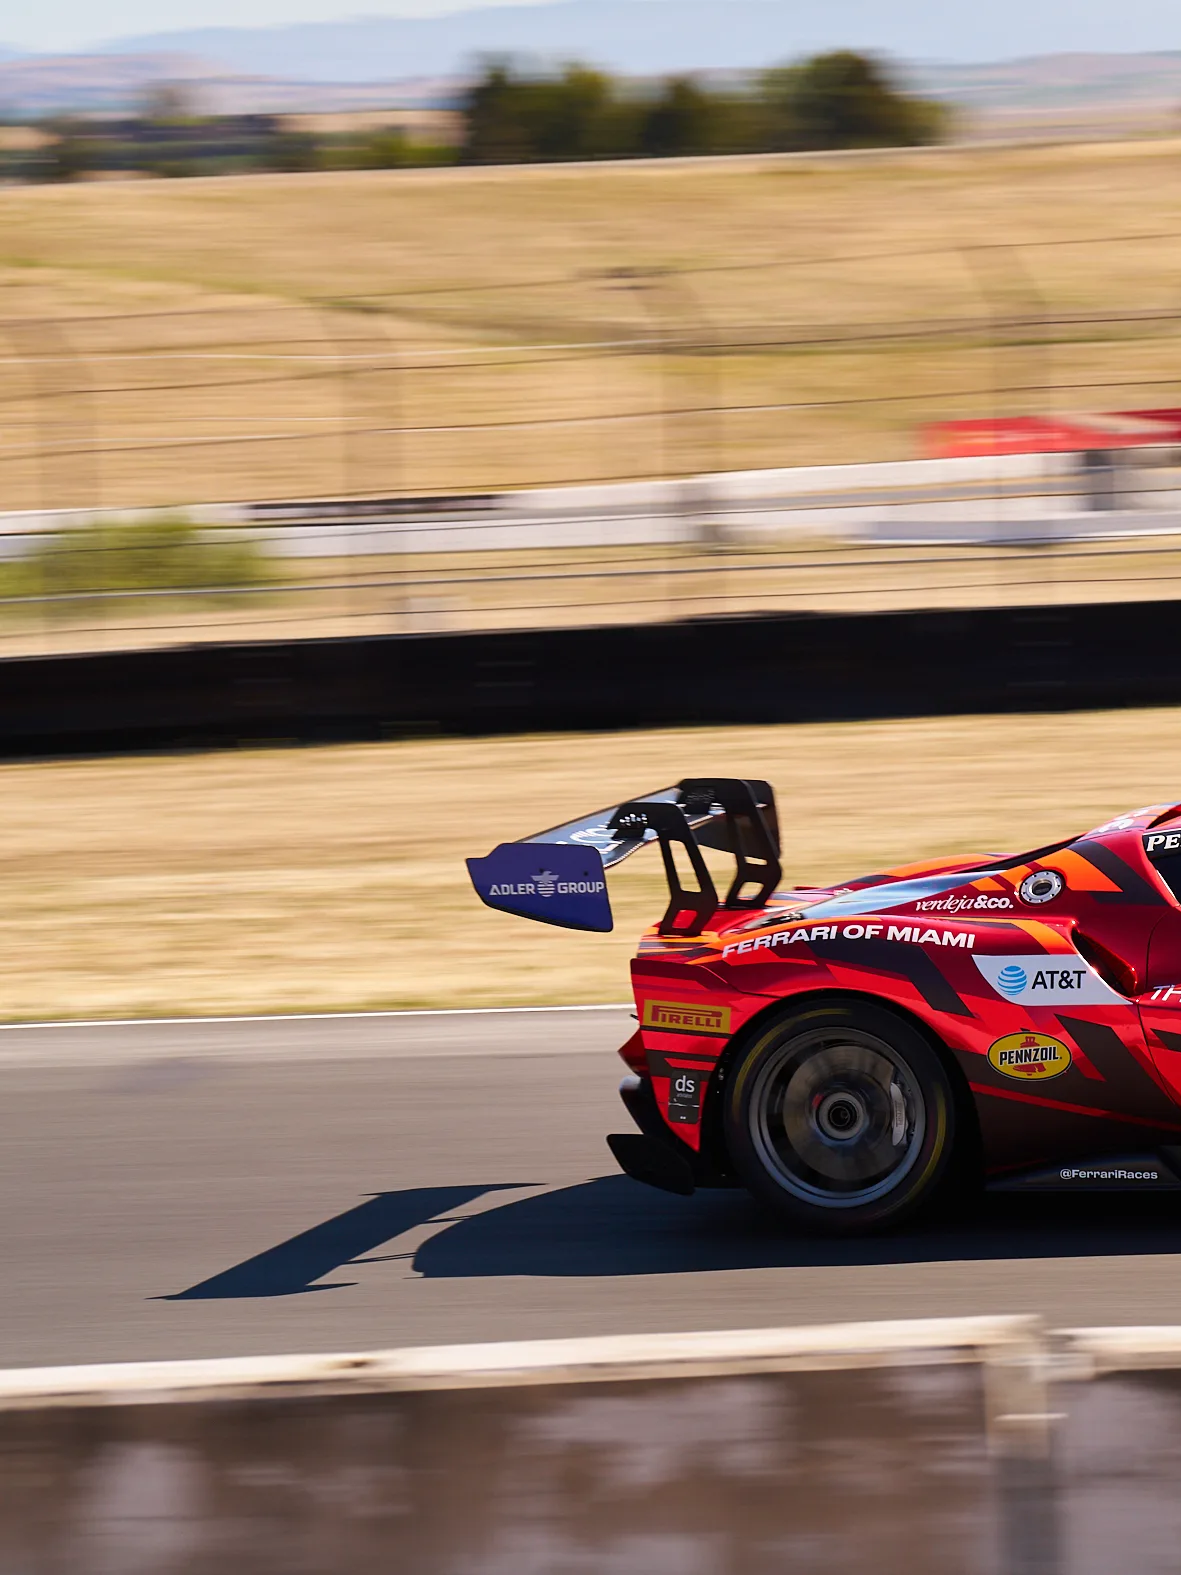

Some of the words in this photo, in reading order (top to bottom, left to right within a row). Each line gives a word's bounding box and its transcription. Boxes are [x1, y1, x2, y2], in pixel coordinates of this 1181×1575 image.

[489, 883, 536, 896] ADLER
[557, 881, 605, 894] GROUP
[915, 895, 1014, 913] verdeja&co.
[722, 926, 837, 958] FERRARI
[842, 924, 884, 940] OF
[887, 926, 976, 949] MIAMI
[1031, 970, 1087, 990] AT&T
[651, 1004, 723, 1028] PIRELLI
[675, 1075, 695, 1093] ds
[1060, 1168, 1158, 1180] @FerrariRaces
